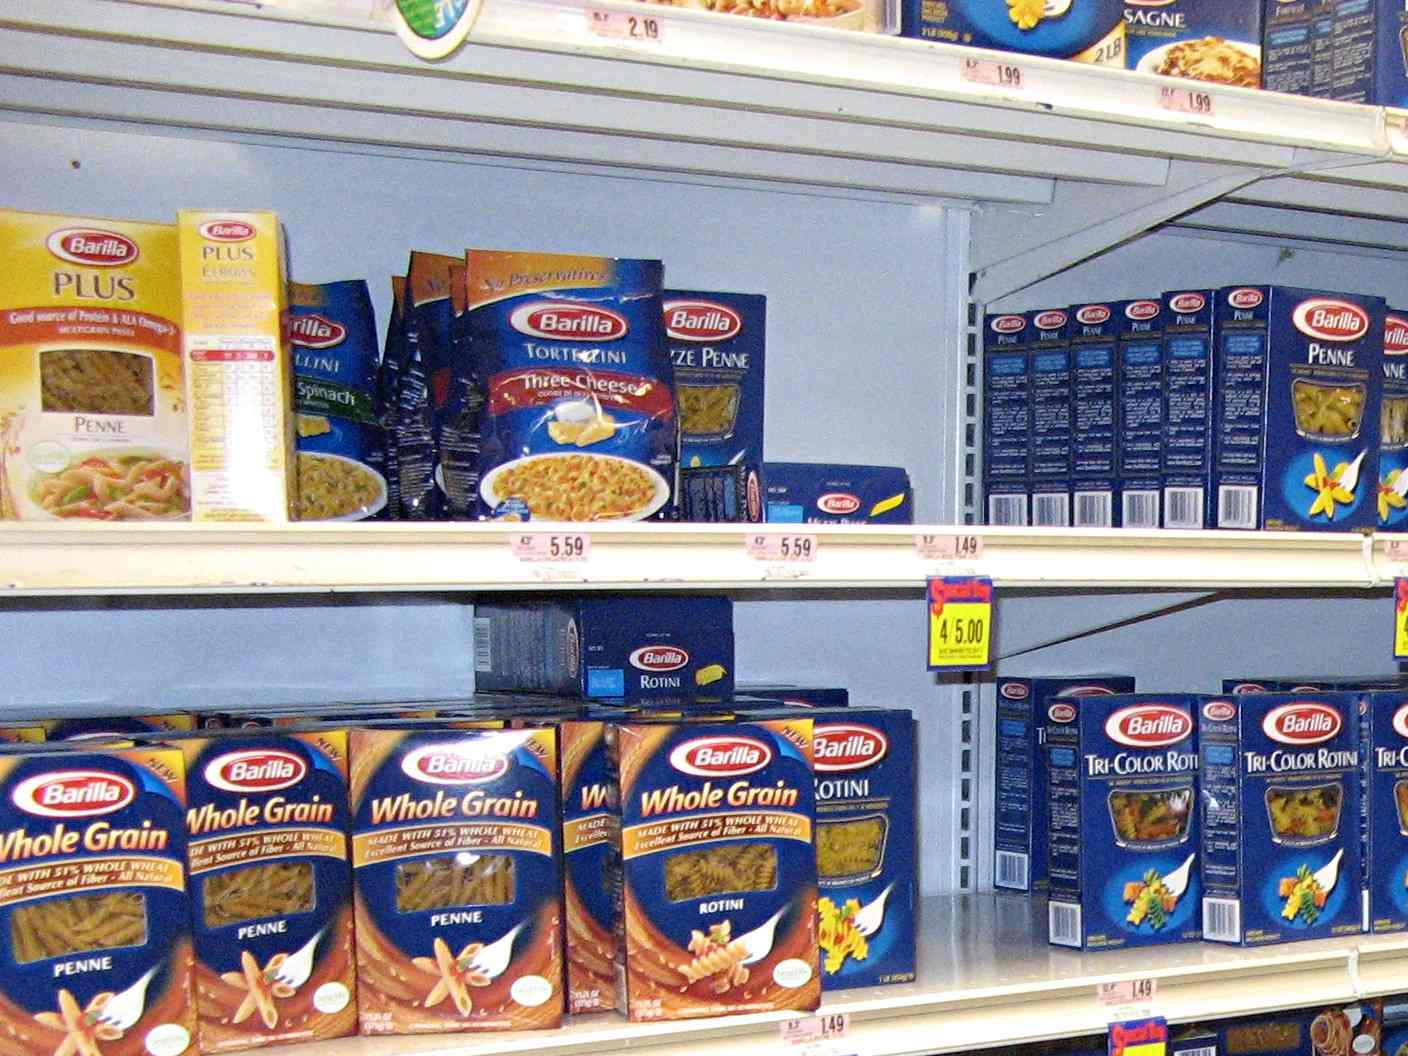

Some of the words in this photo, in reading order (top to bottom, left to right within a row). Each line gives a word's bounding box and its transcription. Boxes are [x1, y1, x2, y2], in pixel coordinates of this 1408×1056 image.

[70, 237, 128, 257] Barilla
[201, 243, 255, 262] PLUS
[54, 273, 135, 300] PLUS
[539, 313, 613, 335] Barilla
[672, 310, 731, 332] Barilla
[1310, 309, 1362, 332] Barilla
[702, 350, 749, 369] PENNE
[1308, 343, 1354, 366] PENNE
[299, 382, 355, 407] Spinach
[522, 373, 570, 391] Three
[574, 373, 638, 395] Cheese
[74, 416, 126, 434] PENNE
[550, 537, 584, 556] 5.59
[781, 537, 812, 557] 5.59
[954, 537, 977, 555] 1.49
[644, 651, 683, 665] Barilla
[640, 675, 681, 689] ROTINI
[1127, 717, 1184, 735] Barilla
[1282, 715, 1333, 734] Barilla
[815, 736, 875, 759] Barilla
[694, 747, 759, 770] Barilla
[1085, 753, 1164, 776] TRI-COLOR
[1166, 752, 1199, 771] ROTI
[1244, 751, 1316, 773] TRI-COLOR
[1317, 749, 1358, 769] ROTINI
[229, 761, 294, 782] Barilla
[42, 781, 121, 806] Barilla
[641, 786, 723, 815] Whole
[726, 780, 798, 810] Grain
[264, 795, 333, 824] Grain
[371, 790, 457, 824] Whole
[461, 788, 538, 820] Grain
[84, 820, 168, 851] Grain
[699, 898, 744, 914] ROTINI
[430, 910, 482, 927] PENNE
[238, 920, 287, 940] PENNE
[54, 956, 112, 977] PENNE
[1132, 979, 1152, 998] 1.49
[821, 1016, 844, 1033] 1.49
